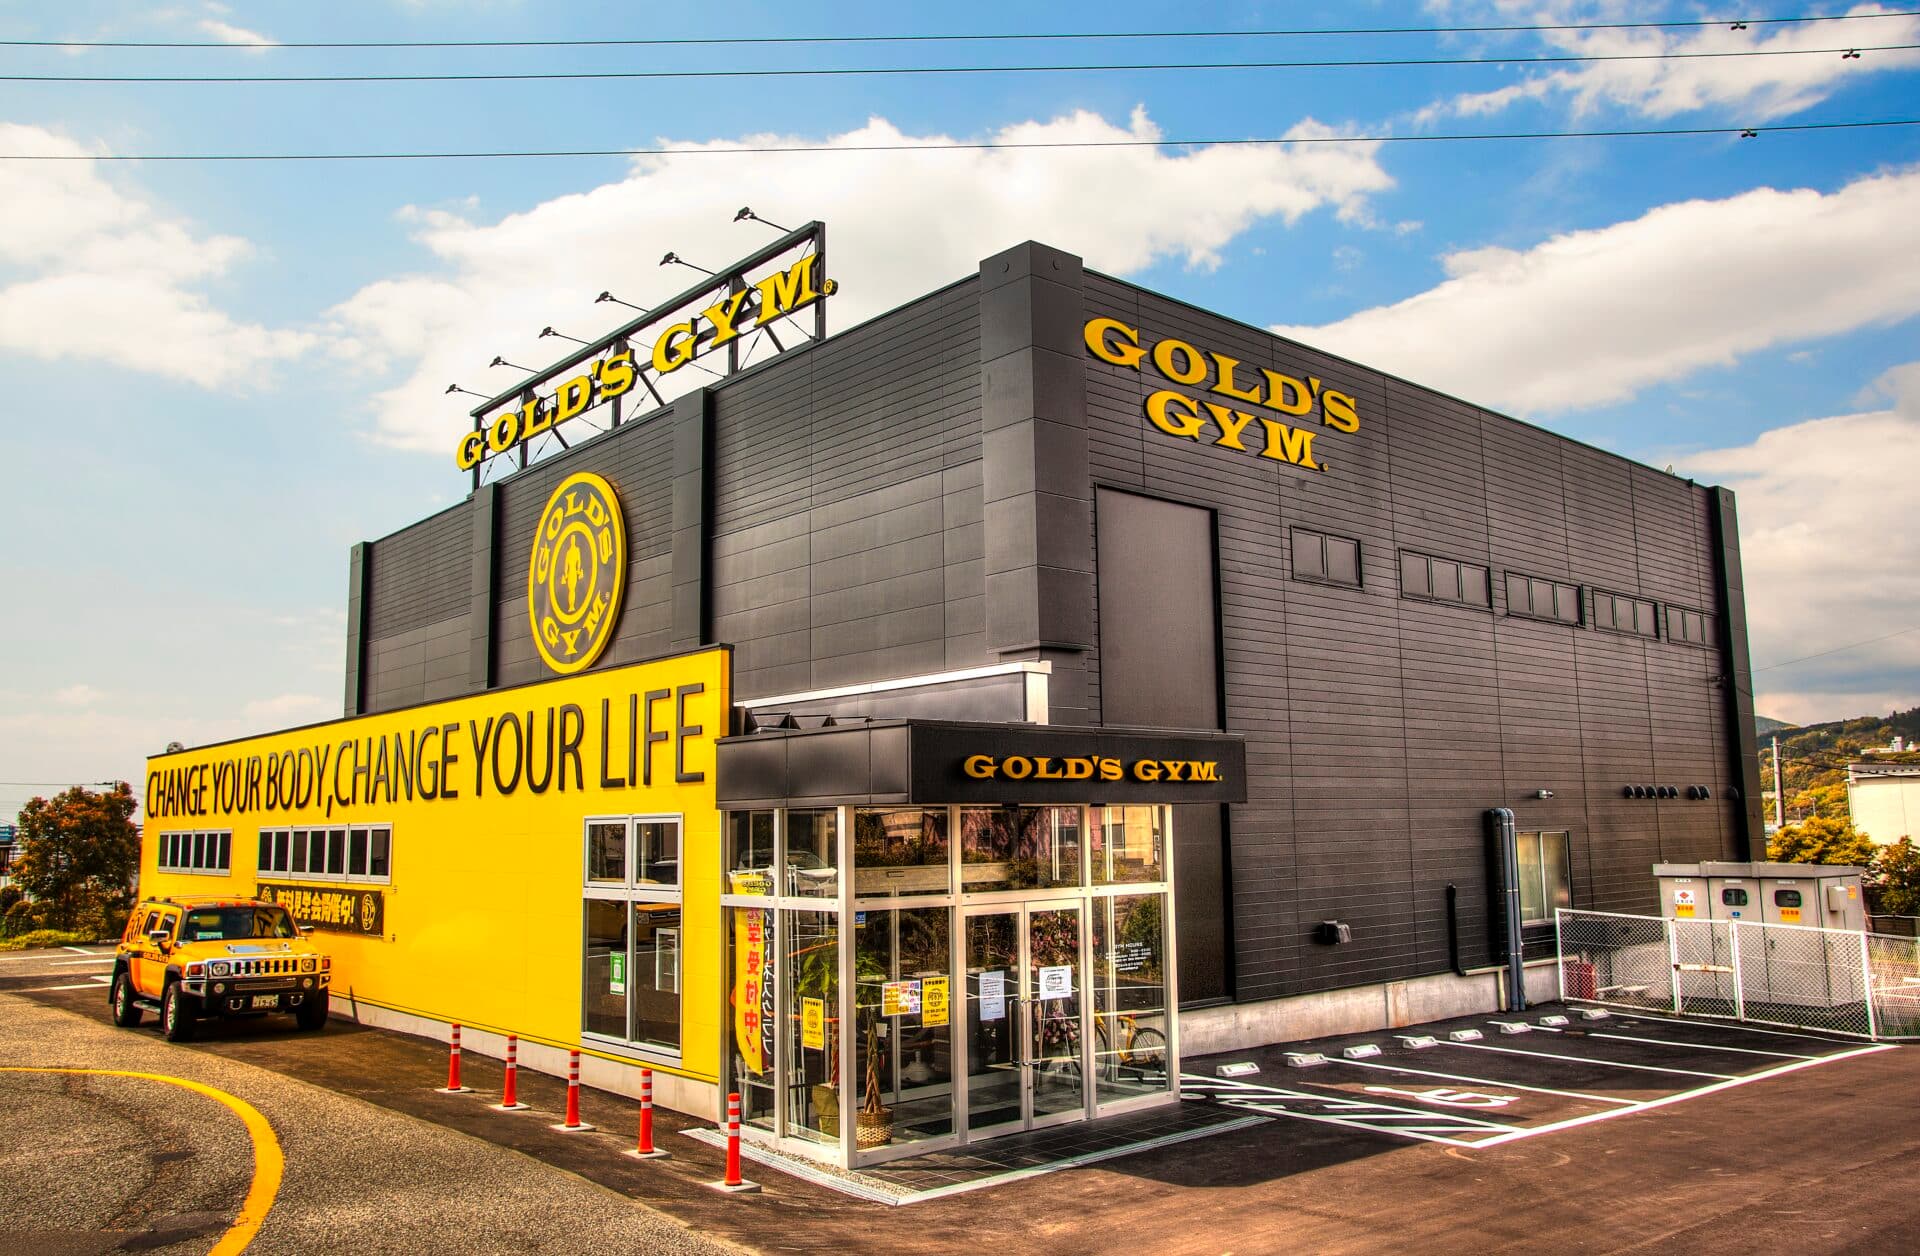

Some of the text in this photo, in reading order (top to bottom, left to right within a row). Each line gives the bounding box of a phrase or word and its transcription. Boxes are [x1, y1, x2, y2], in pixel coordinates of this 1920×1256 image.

[456, 347, 635, 471] GOLD'S
[1083, 317, 1360, 434] GOLD'S
[537, 491, 613, 584] GOLD'S
[146, 762, 209, 819] CHANGE
[212, 756, 262, 815] YOUR
[334, 722, 460, 807] CHANGE
[470, 703, 586, 798] YOUR
[601, 682, 706, 791] LIFE
[963, 754, 1124, 781] GOLD'S
